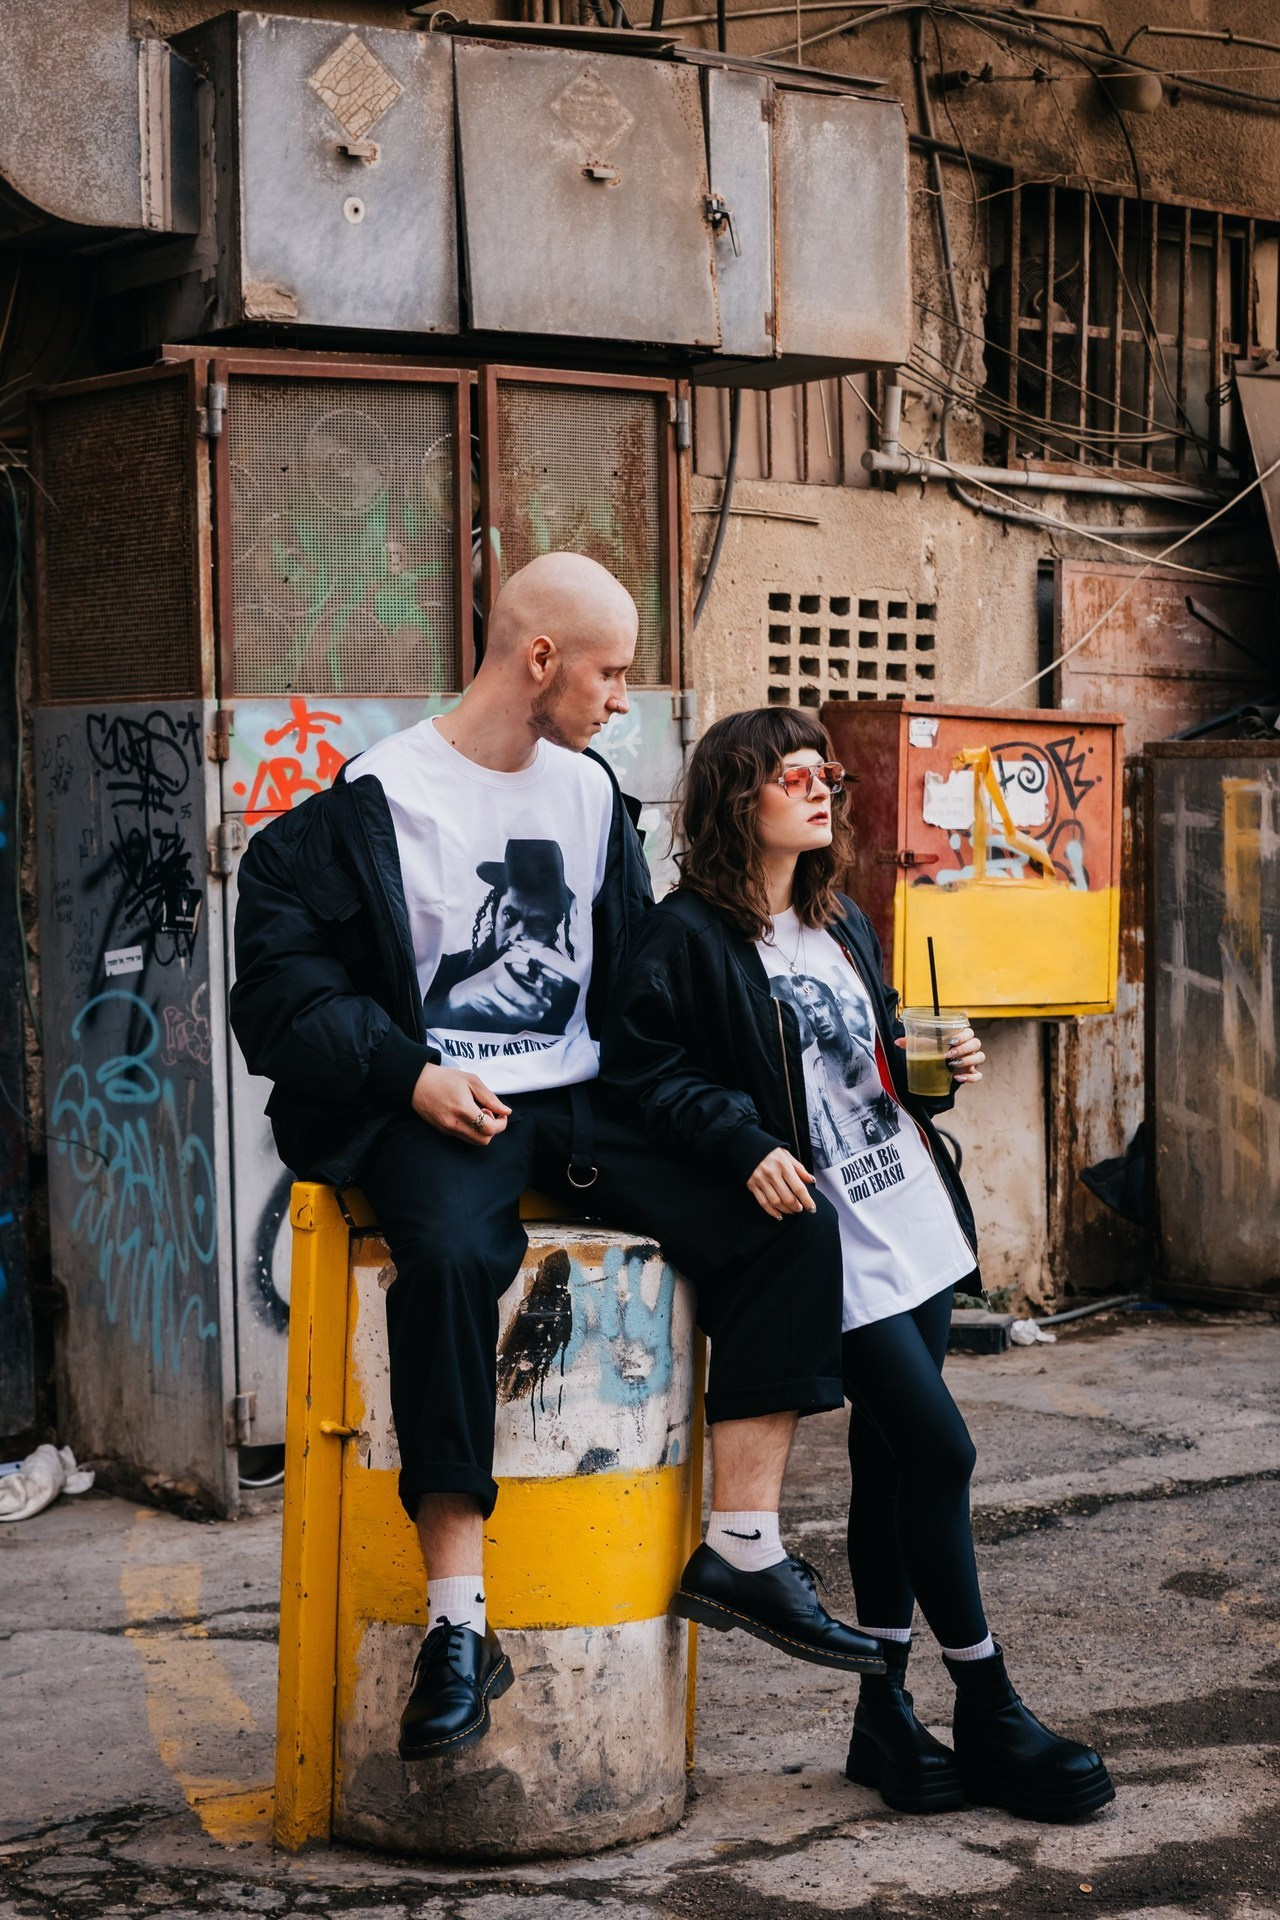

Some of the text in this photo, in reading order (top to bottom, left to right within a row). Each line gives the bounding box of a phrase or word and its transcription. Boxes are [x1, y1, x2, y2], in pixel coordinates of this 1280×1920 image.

[444, 1038, 475, 1060] KISS
[478, 1043, 500, 1060] MY
[840, 1143, 901, 1186] DREAM BIG
[847, 1161, 906, 1205] and EBASH
